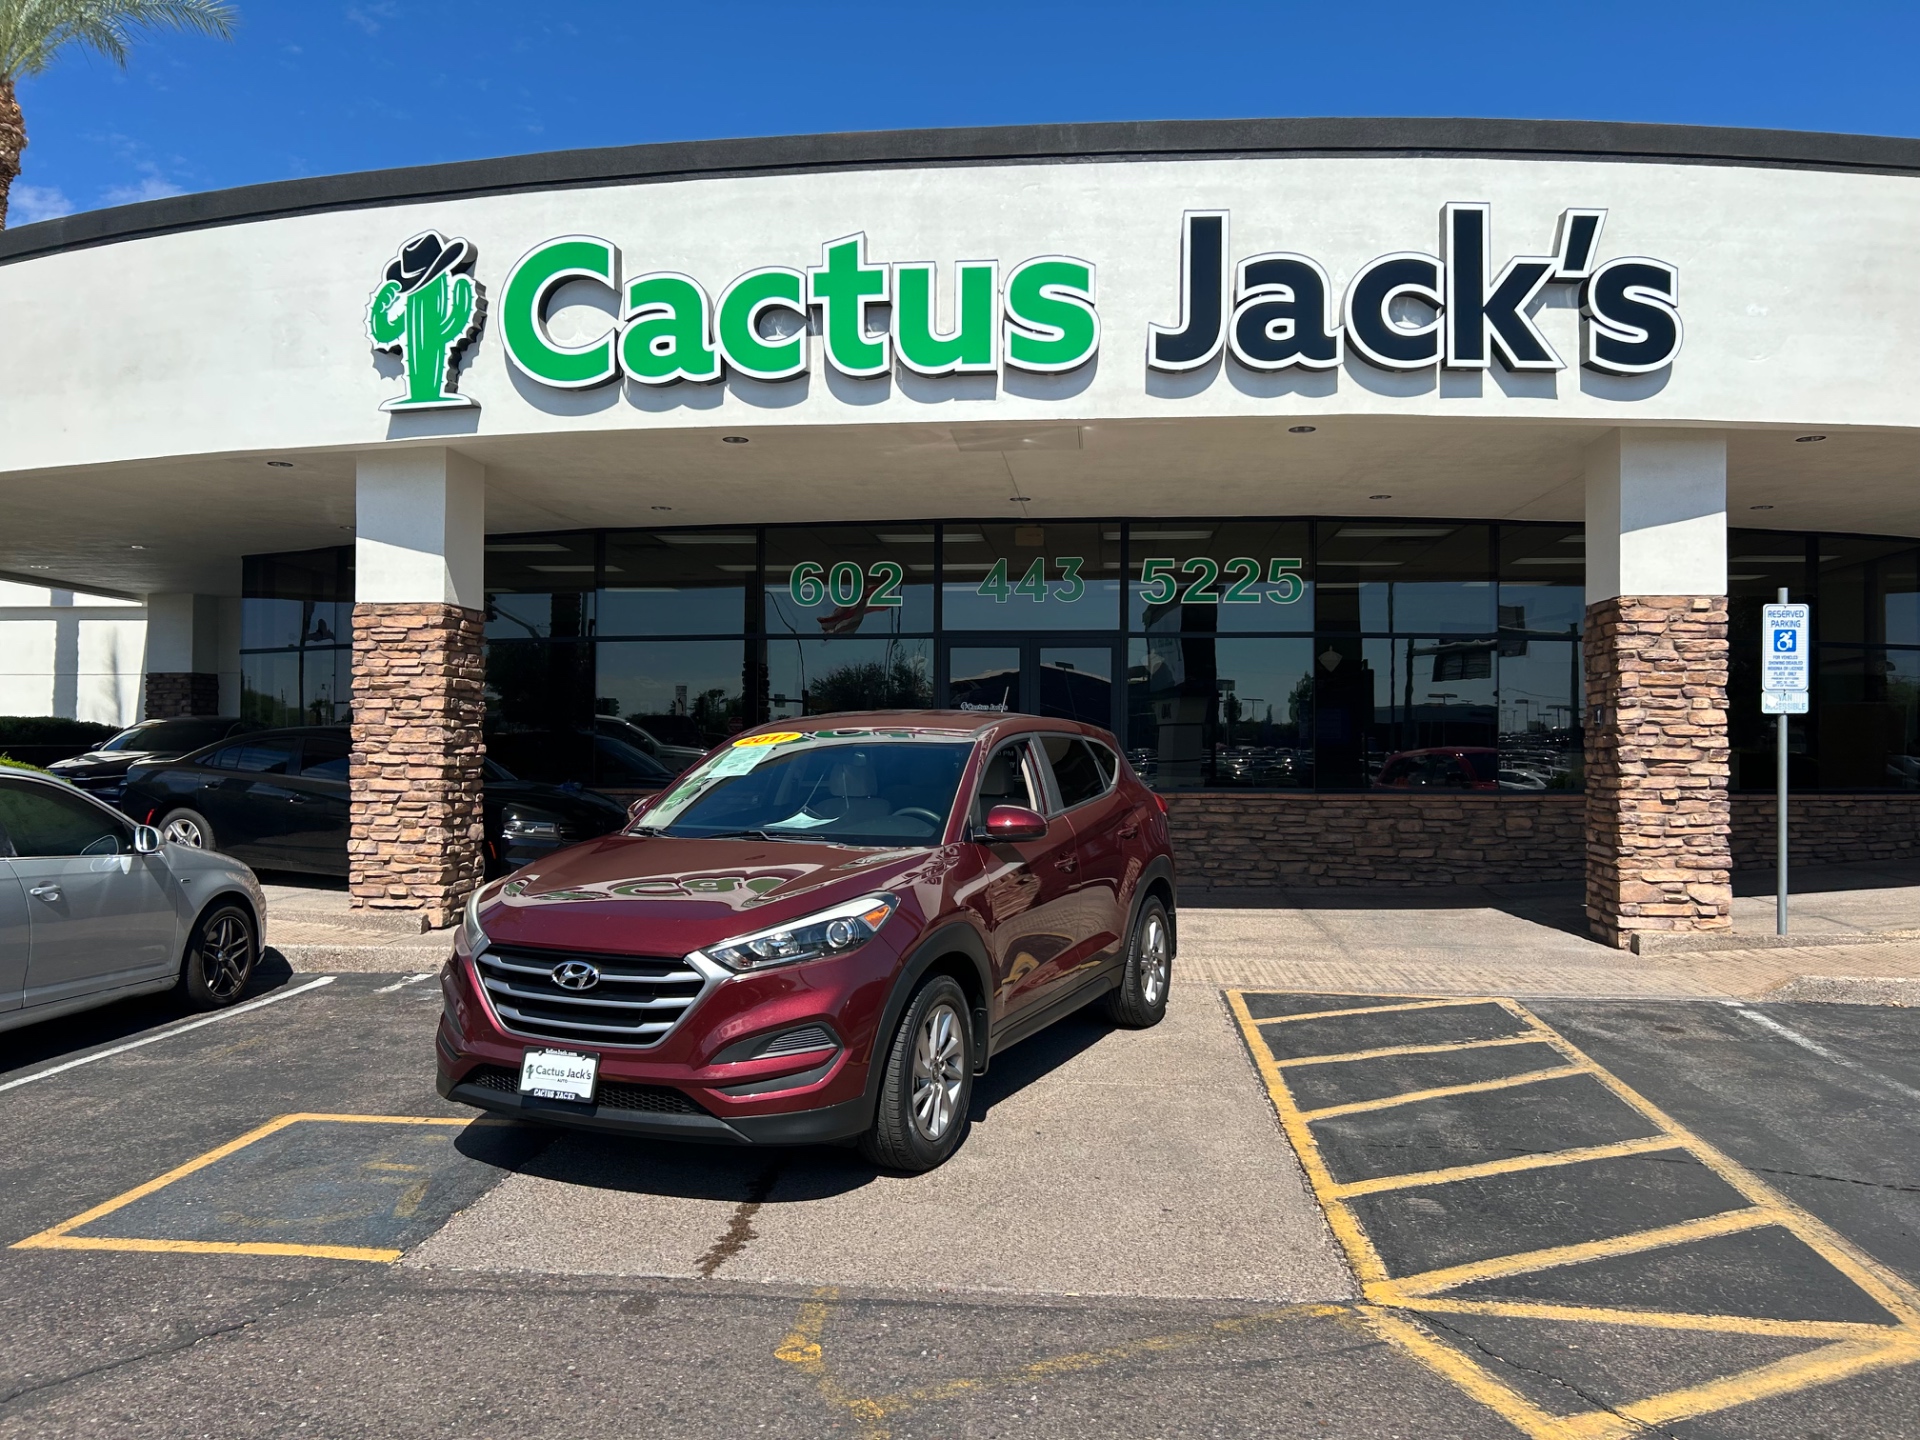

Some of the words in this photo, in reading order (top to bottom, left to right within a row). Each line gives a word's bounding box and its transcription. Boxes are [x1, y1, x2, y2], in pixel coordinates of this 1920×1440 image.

[499, 232, 1101, 388] Cactus
[1148, 202, 1683, 372] Jack's
[789, 561, 904, 607] 602
[977, 557, 1086, 603] 443
[1139, 558, 1305, 604] 5225
[1767, 610, 1805, 618] RESERVED
[1771, 620, 1801, 628] PARKING
[739, 733, 796, 745] 2017
[535, 1065, 565, 1077] Cactus
[566, 1068, 592, 1080] Jack's
[533, 1089, 554, 1098] CACTUS
